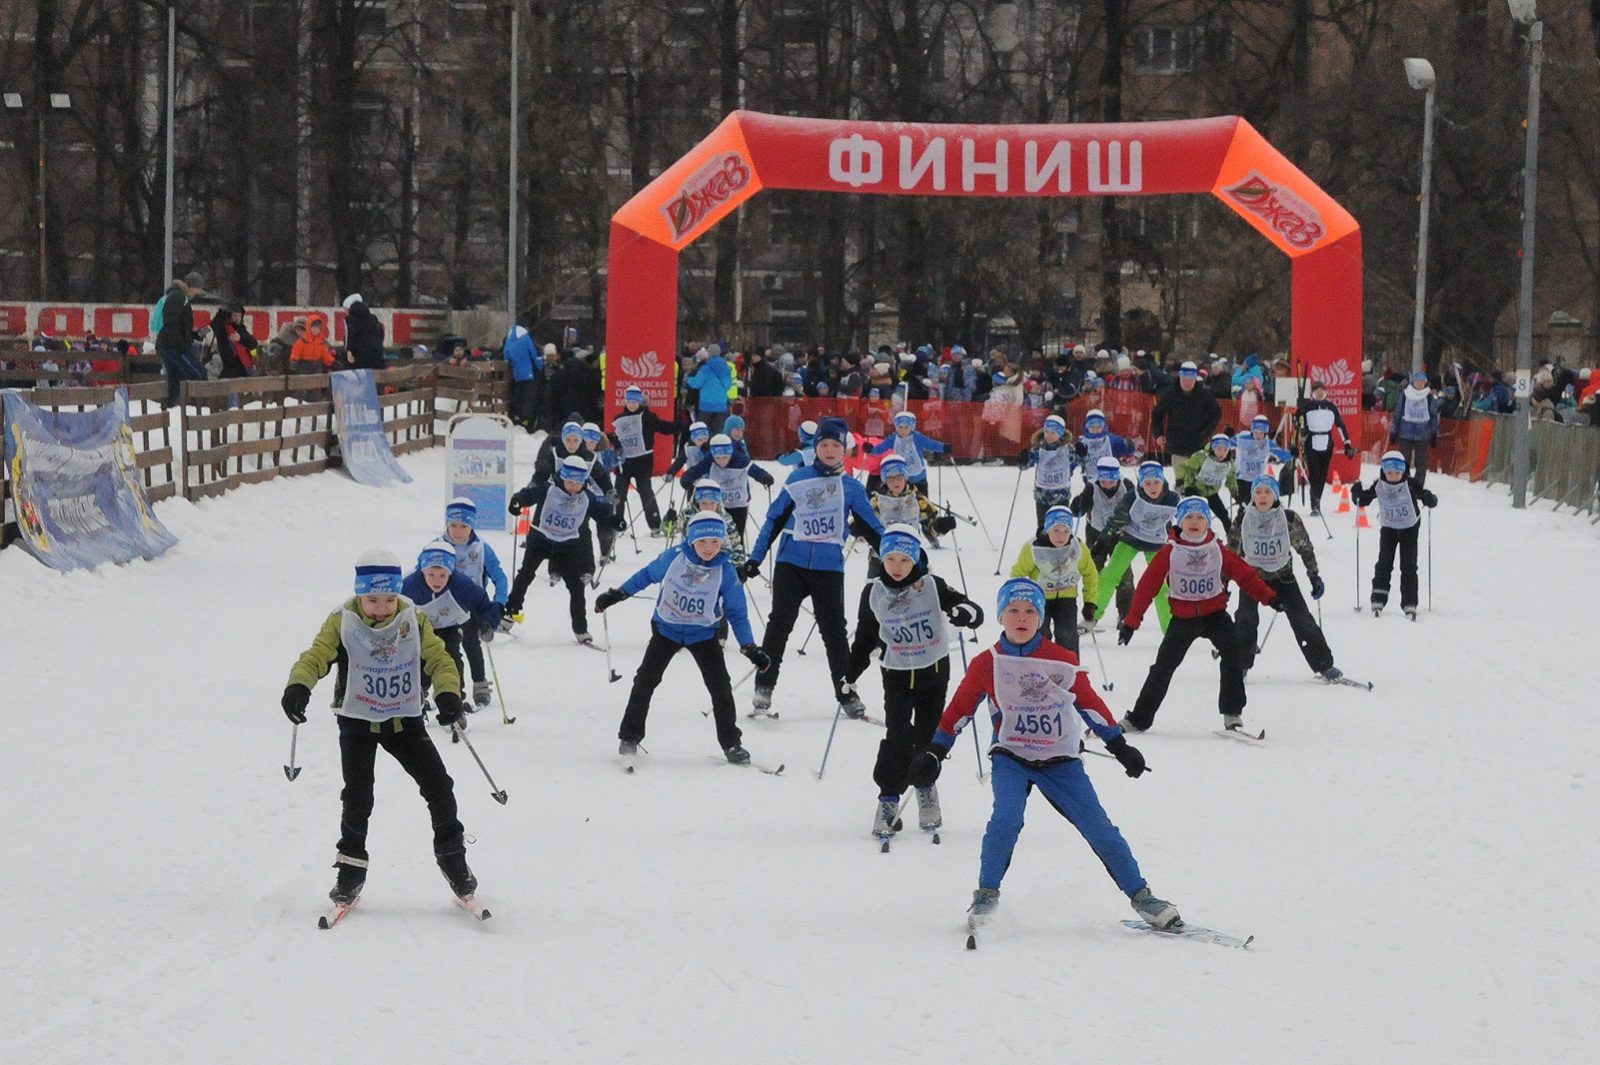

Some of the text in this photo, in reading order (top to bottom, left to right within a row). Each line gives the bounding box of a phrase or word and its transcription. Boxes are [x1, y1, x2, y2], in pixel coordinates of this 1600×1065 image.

[829, 133, 1143, 194] ФИНИШ
[1518, 378, 1526, 389] 8
[803, 516, 835, 536] 3054
[1253, 540, 1282, 556] 3051
[1180, 578, 1213, 593] 3066
[672, 590, 705, 615] 3069
[891, 619, 933, 643] 3075
[363, 672, 412, 699] 3058
[1014, 712, 1062, 737] 4561
